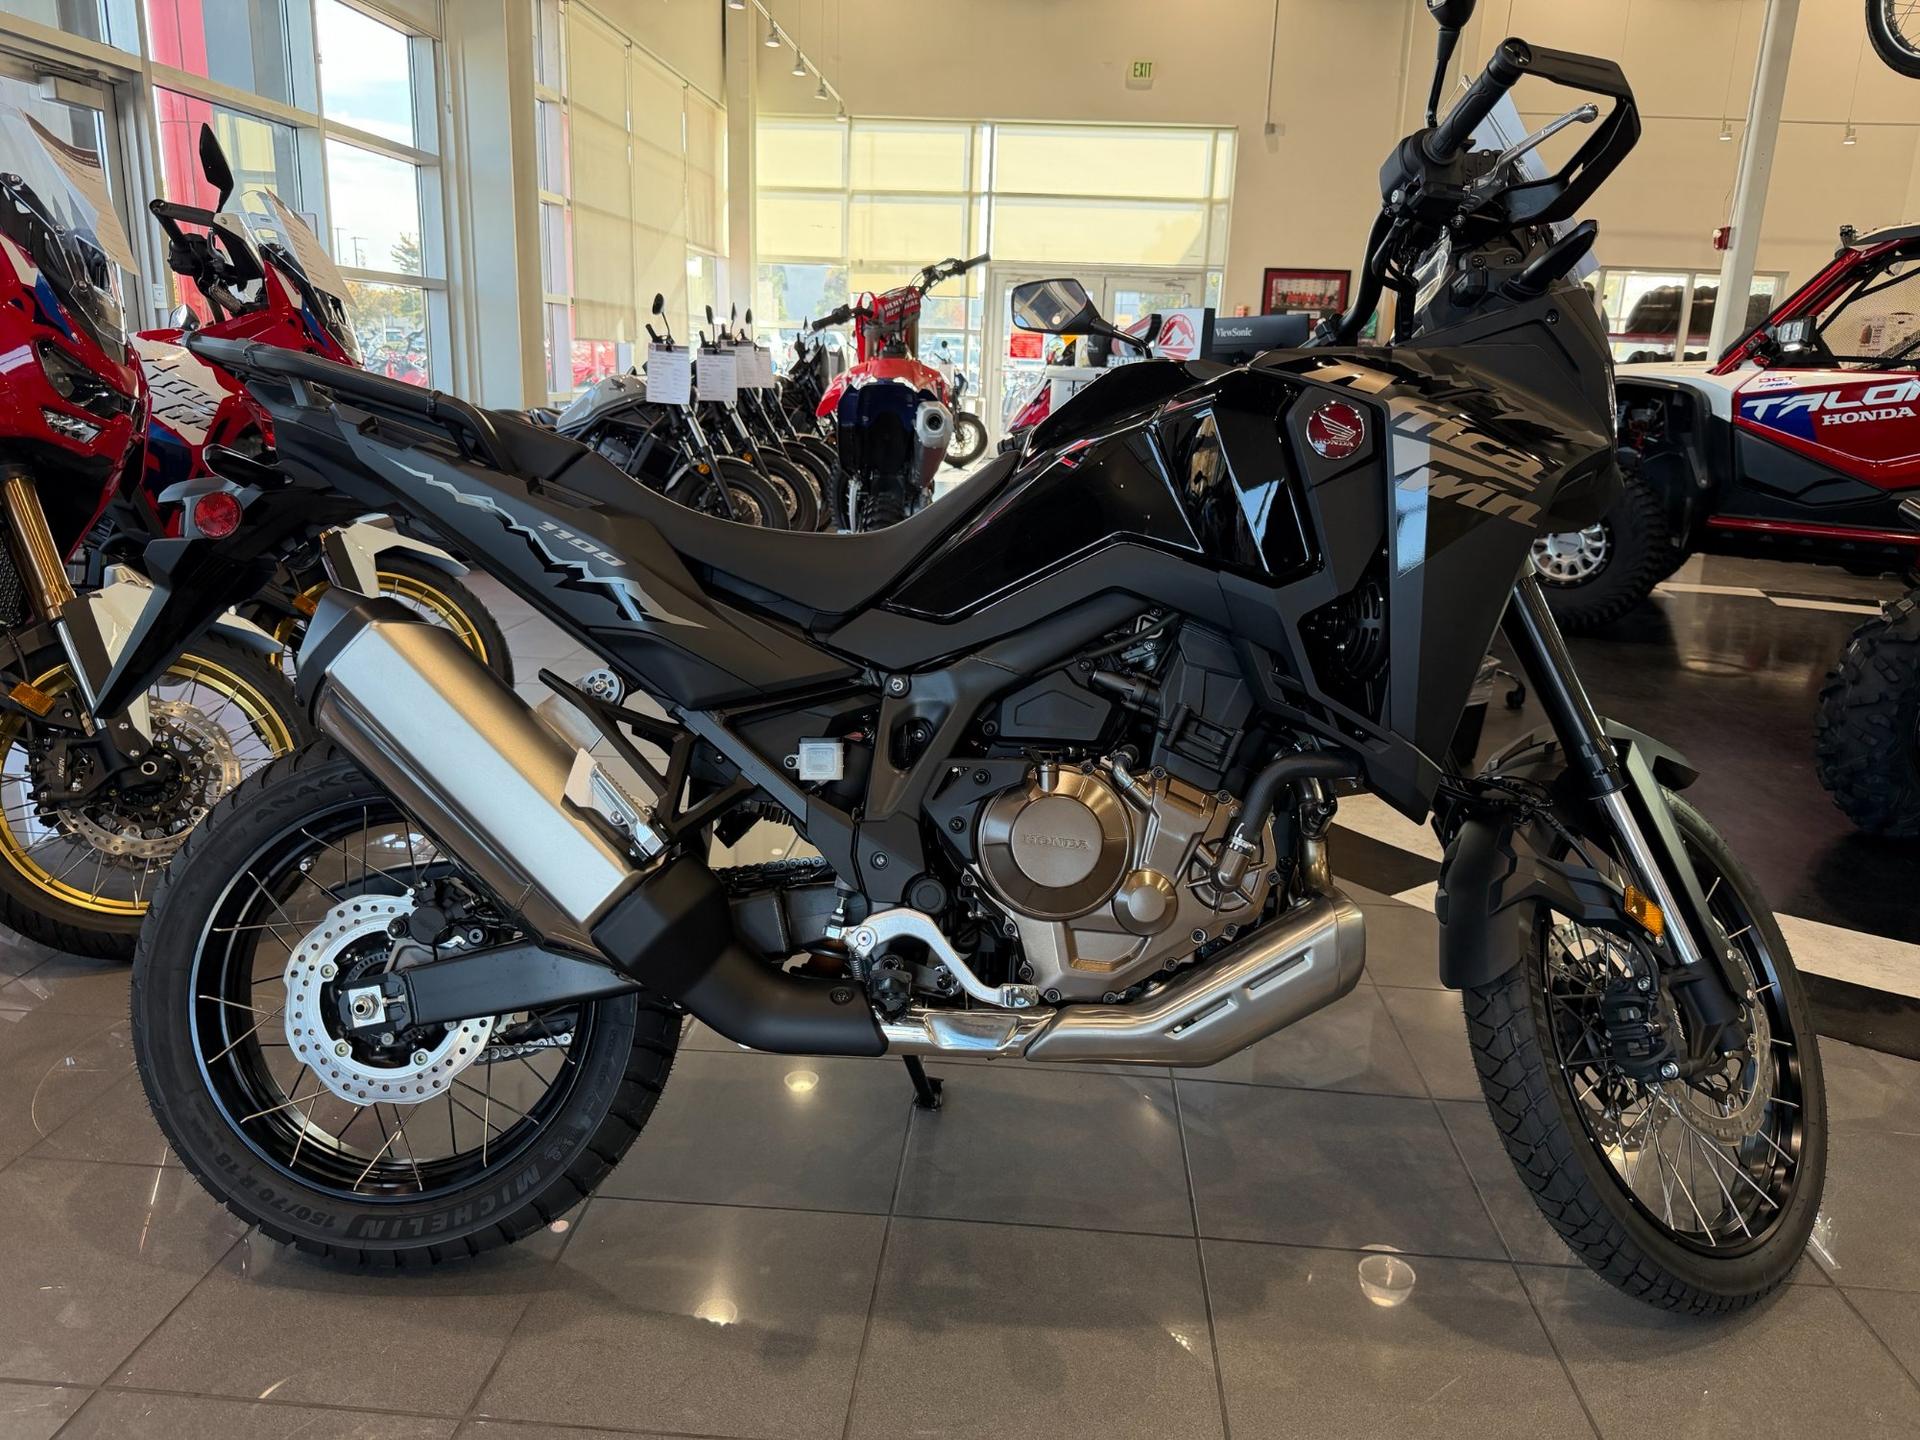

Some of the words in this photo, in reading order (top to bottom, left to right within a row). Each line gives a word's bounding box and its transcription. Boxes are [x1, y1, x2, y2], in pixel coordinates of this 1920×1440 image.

[1133, 62, 1153, 78] EXIT
[884, 292, 919, 311] RENTAL
[885, 299, 920, 317] RENHAL
[1215, 327, 1253, 337] ViewSonic
[1107, 354, 1144, 368] HON
[1822, 406, 1917, 426] HONDA
[1314, 438, 1355, 448] HONDA
[537, 521, 627, 567] 1100
[256, 770, 364, 822] ANAKE
[1023, 833, 1090, 850] HONDA
[359, 1163, 542, 1239] MICHELIN
